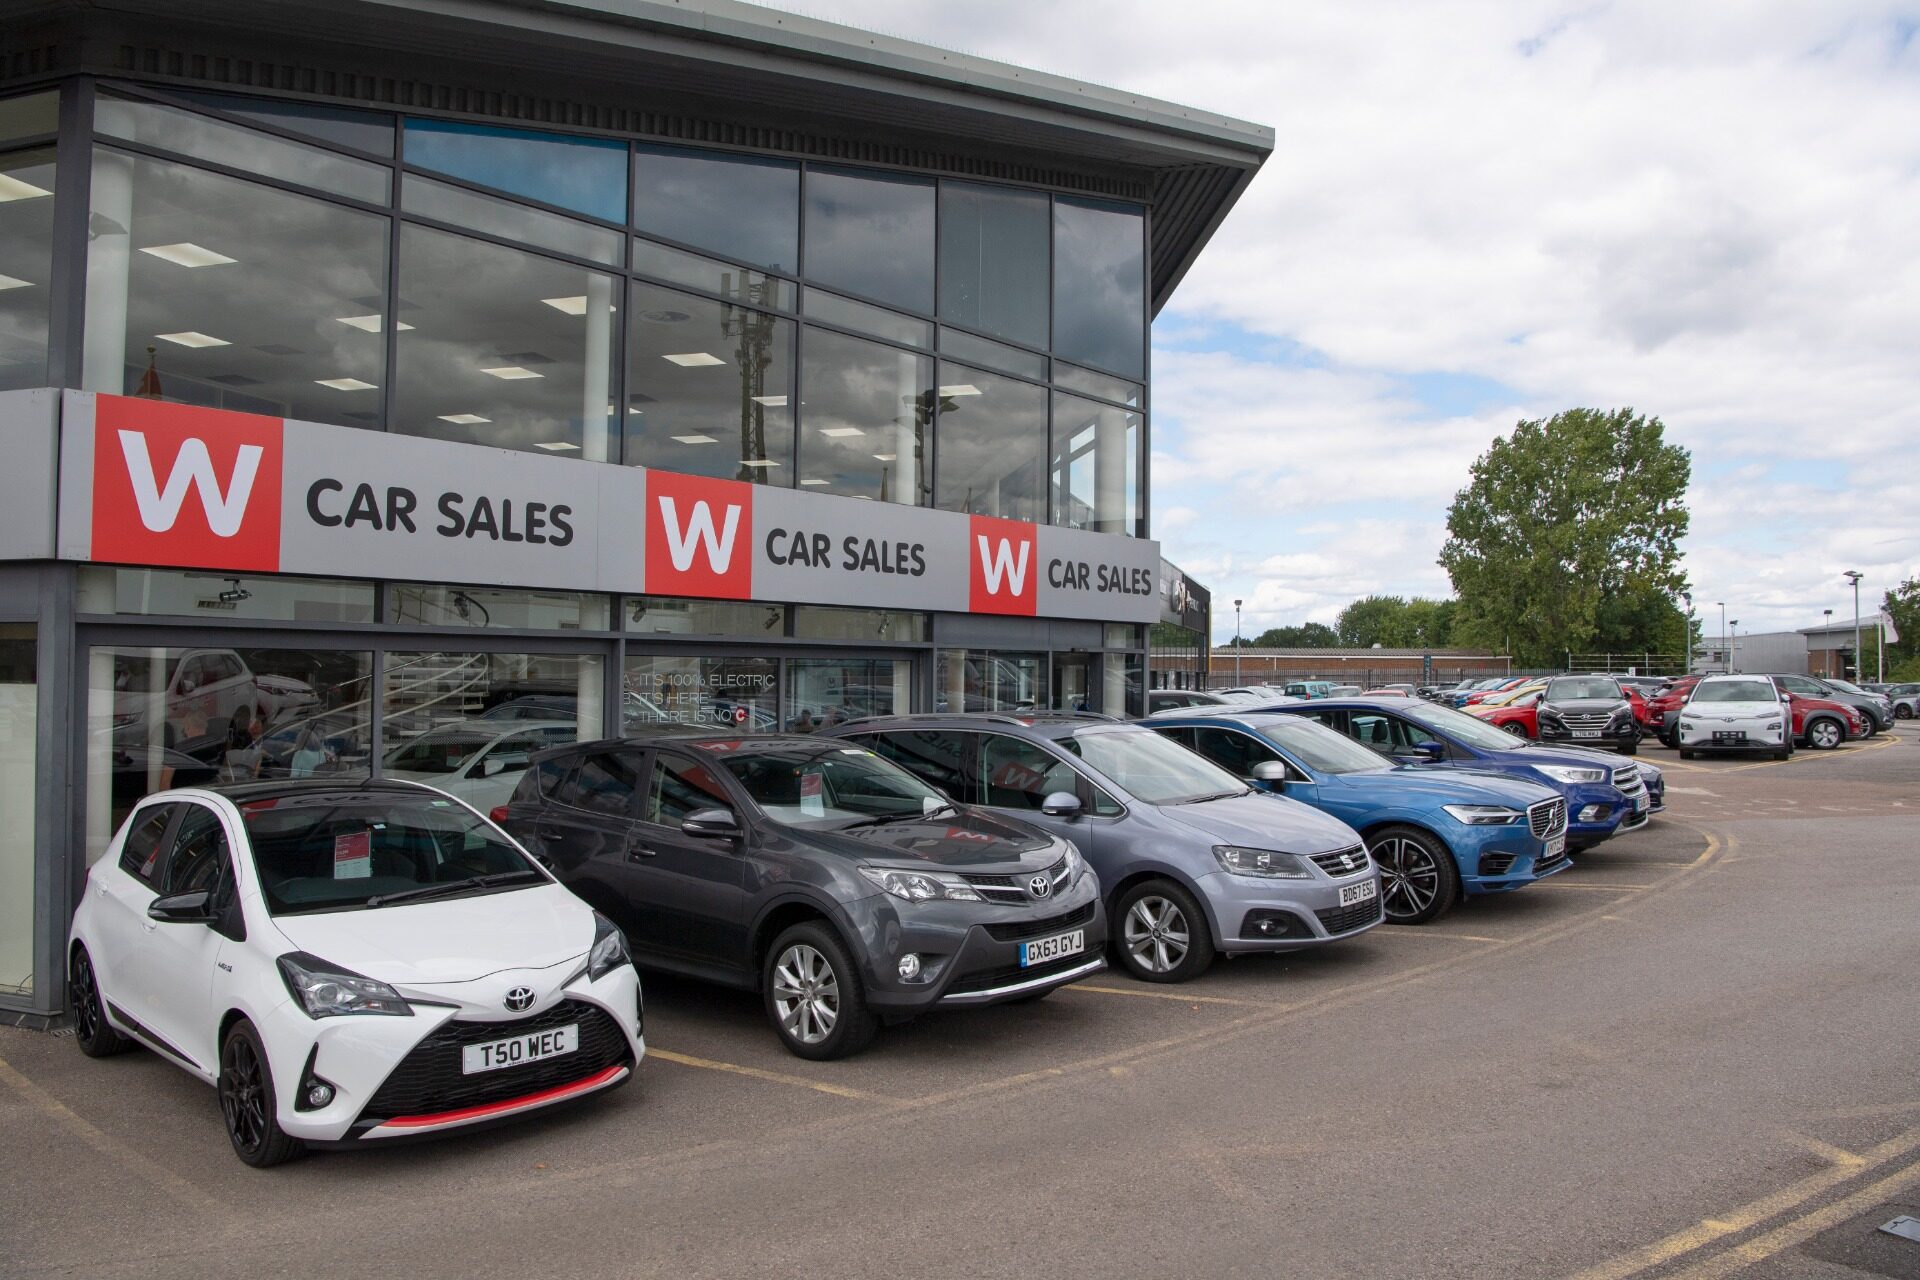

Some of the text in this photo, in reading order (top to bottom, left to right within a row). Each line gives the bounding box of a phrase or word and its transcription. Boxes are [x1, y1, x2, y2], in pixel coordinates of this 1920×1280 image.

[118, 429, 264, 537] W
[306, 478, 575, 547] CAR SALES
[658, 495, 742, 575] W
[765, 528, 927, 577] CAR SALES
[977, 535, 1030, 597] W
[1048, 558, 1152, 596] CAR SALES
[639, 674, 664, 686] IT'S
[669, 674, 706, 686] 100%
[709, 674, 775, 687] ELECTRIC
[640, 710, 689, 723] THERE
[694, 710, 706, 723] IS
[710, 710, 732, 723] NO
[1343, 885, 1361, 903] BD67
[1028, 931, 1082, 961] GX63 GYJ
[480, 1030, 565, 1067] T50 WEC
